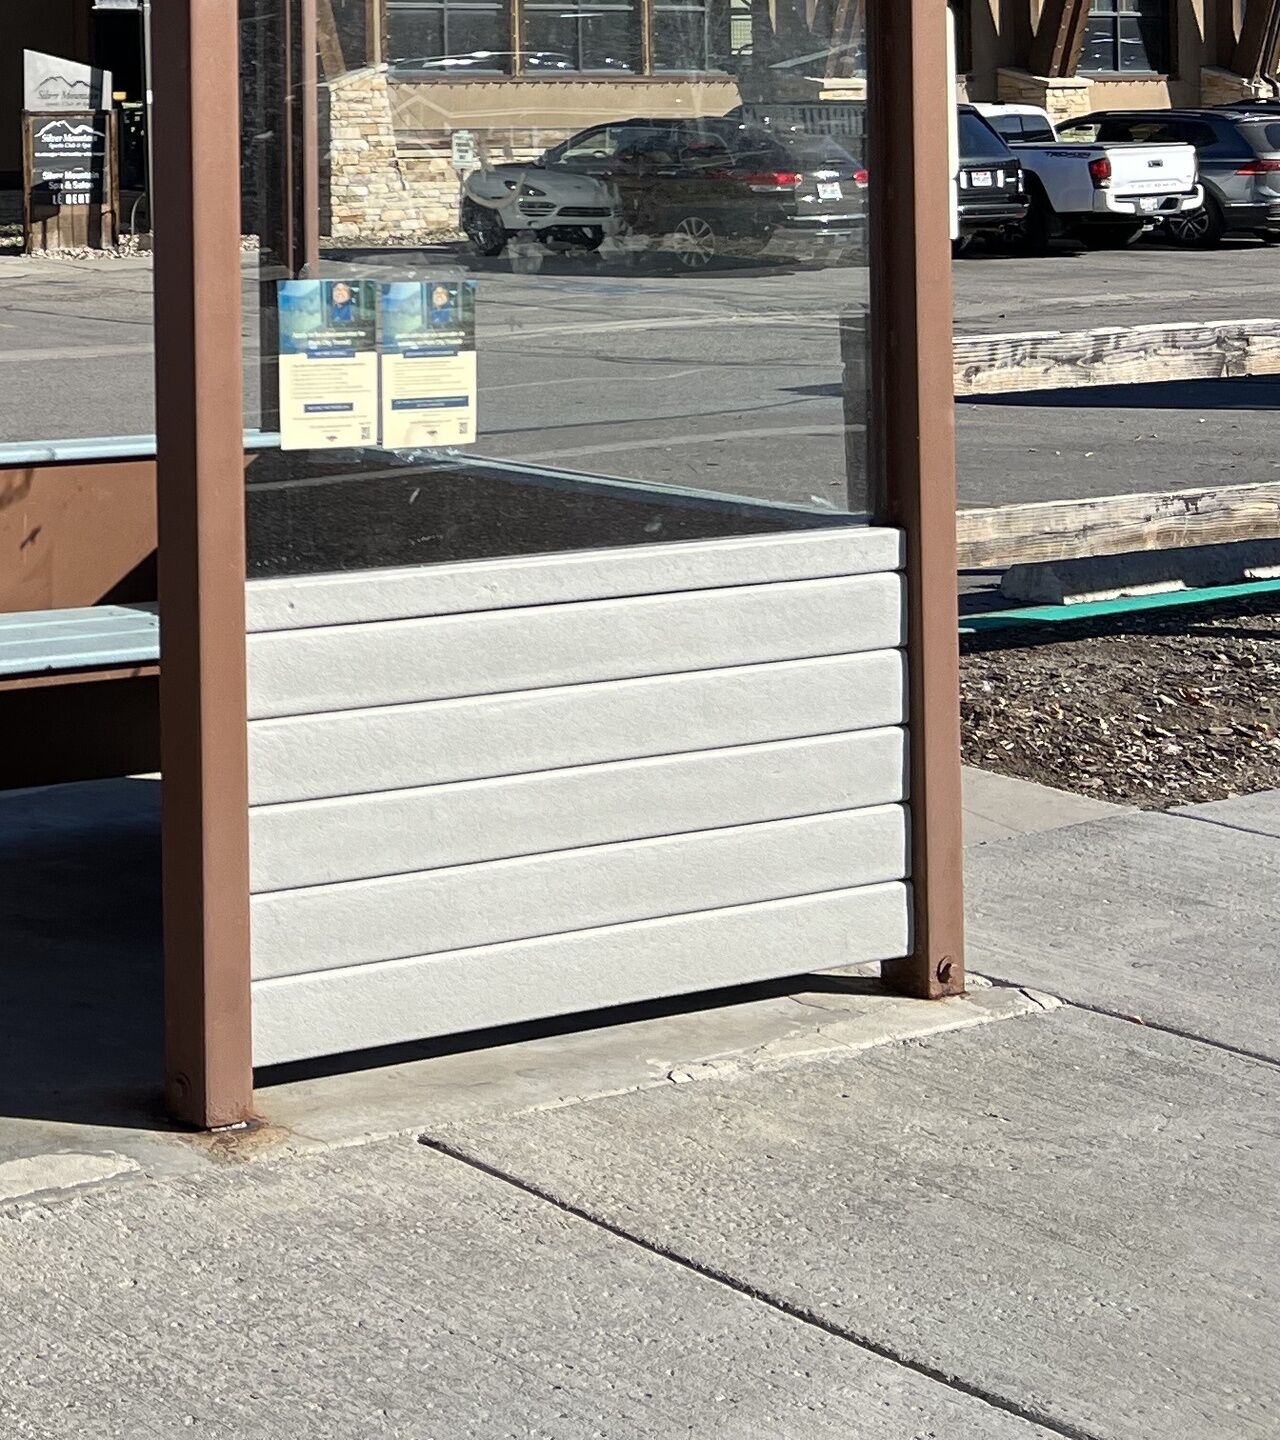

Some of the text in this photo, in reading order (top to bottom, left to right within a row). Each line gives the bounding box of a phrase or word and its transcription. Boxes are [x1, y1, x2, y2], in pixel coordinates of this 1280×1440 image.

[41, 133, 62, 142] Silver
[42, 171, 100, 180] Silver Mountain
[48, 181, 63, 190] Spa
[64, 181, 72, 189] &
